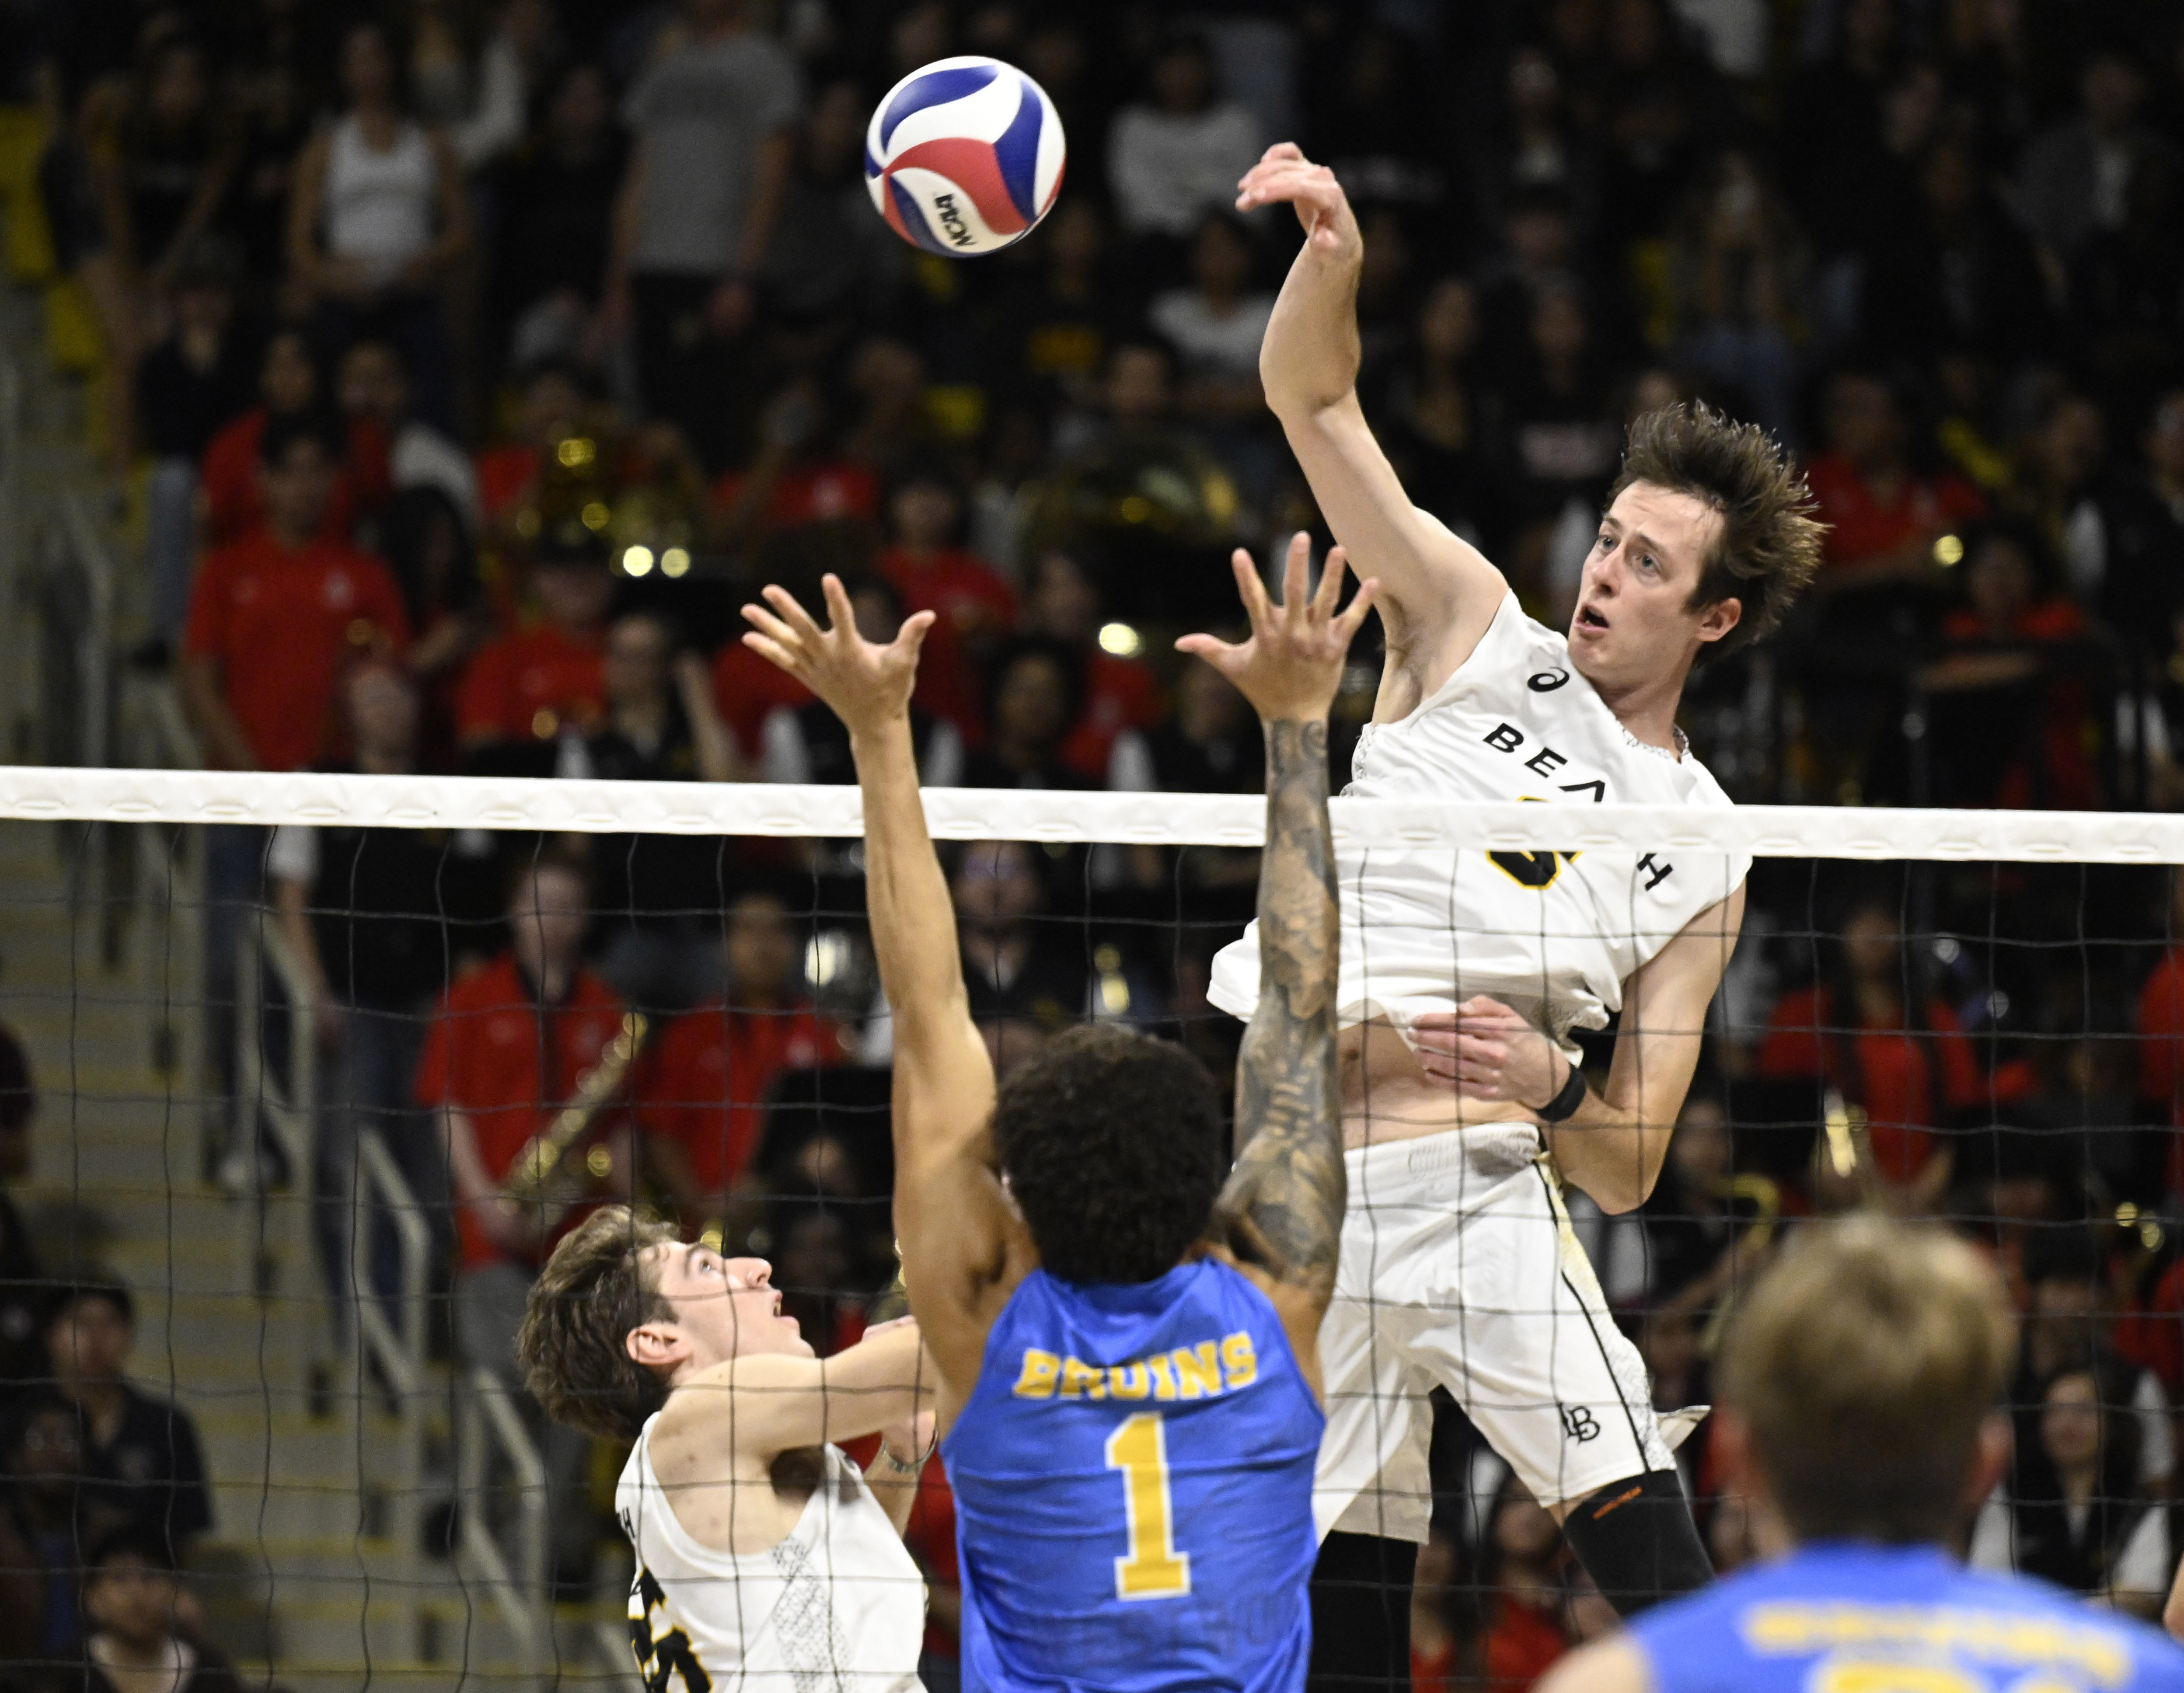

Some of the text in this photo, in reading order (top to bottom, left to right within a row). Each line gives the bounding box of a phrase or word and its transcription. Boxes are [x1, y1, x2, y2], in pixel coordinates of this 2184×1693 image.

[934, 193, 976, 247] NCAA
[1483, 722, 1673, 892] BEAH
[1012, 1330, 1259, 1402] BRUINS
[1104, 1409, 1192, 1603] 1
